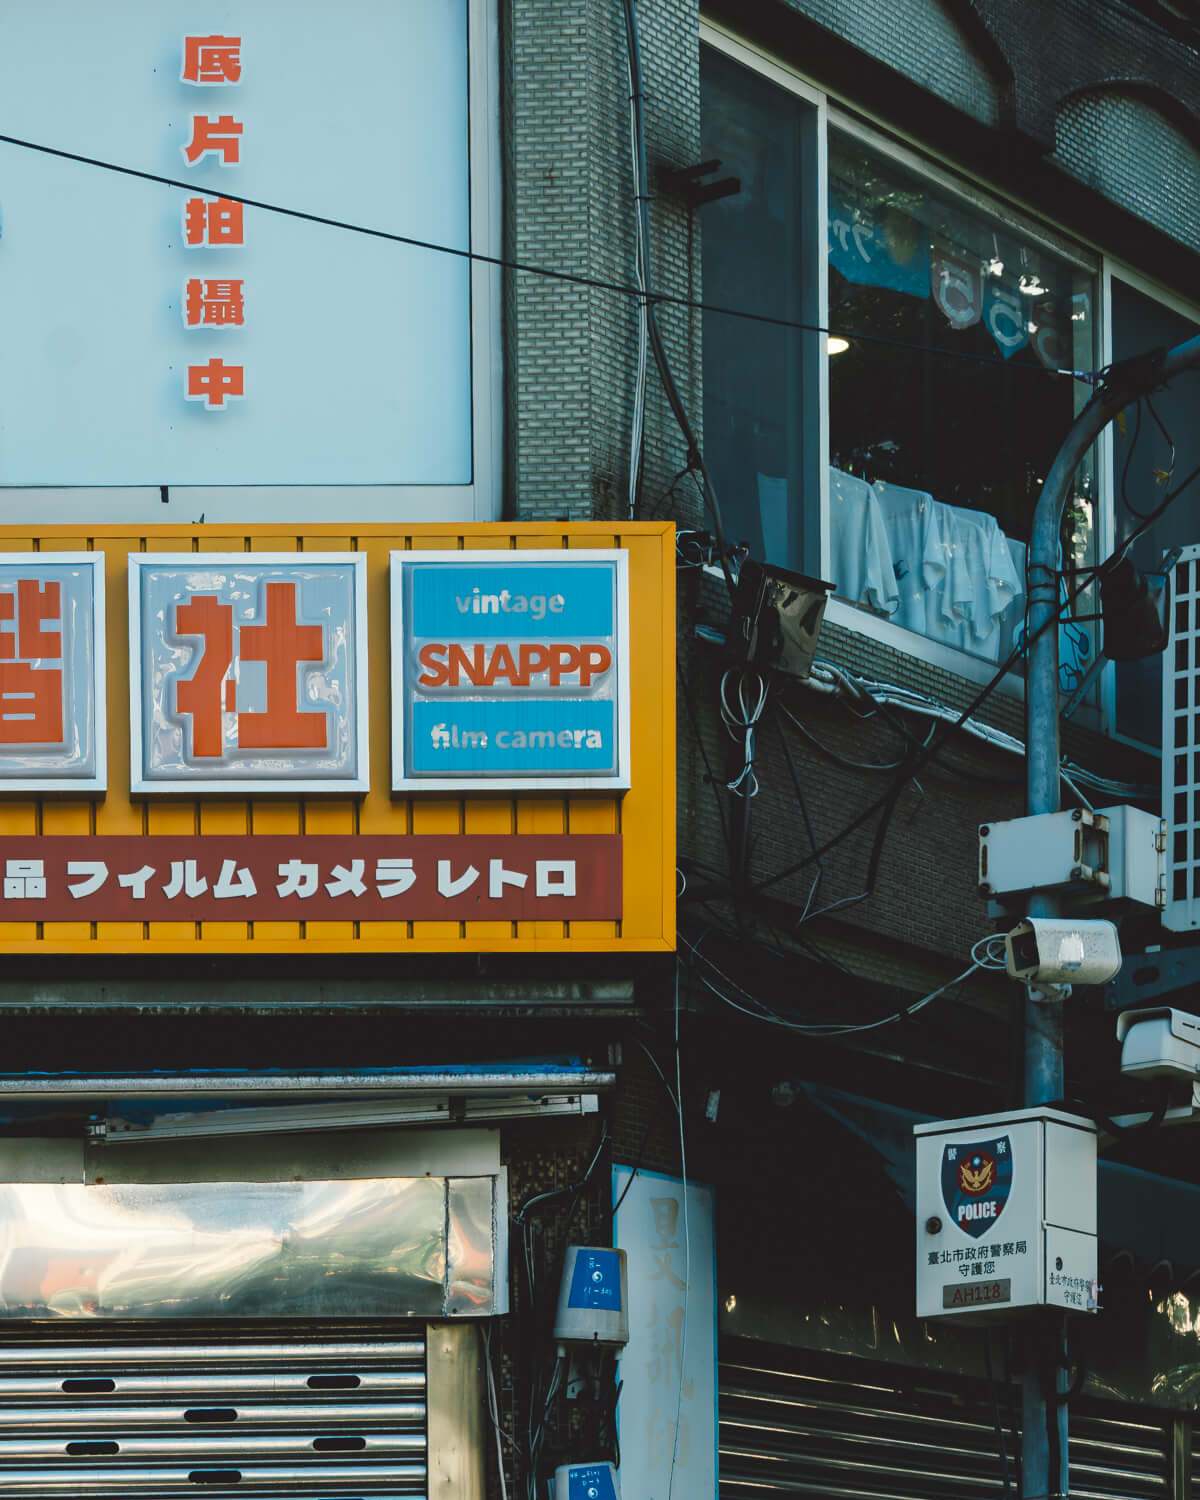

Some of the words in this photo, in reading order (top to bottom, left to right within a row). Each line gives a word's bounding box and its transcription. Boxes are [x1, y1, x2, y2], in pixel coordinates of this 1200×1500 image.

[183, 35, 244, 405] 底片拍攝中
[456, 587, 565, 620] vintage
[418, 643, 611, 687] SNAPPP
[430, 723, 488, 749] film
[495, 728, 602, 749] camera
[67, 859, 258, 899] フィルム
[275, 858, 417, 899] カメラ
[437, 858, 577, 898] レトロ
[957, 1201, 998, 1222] POLICE
[927, 1240, 1028, 1266] 臺北市政府警察局
[958, 1261, 996, 1277] 守護您
[952, 1282, 1001, 1304] AH118
